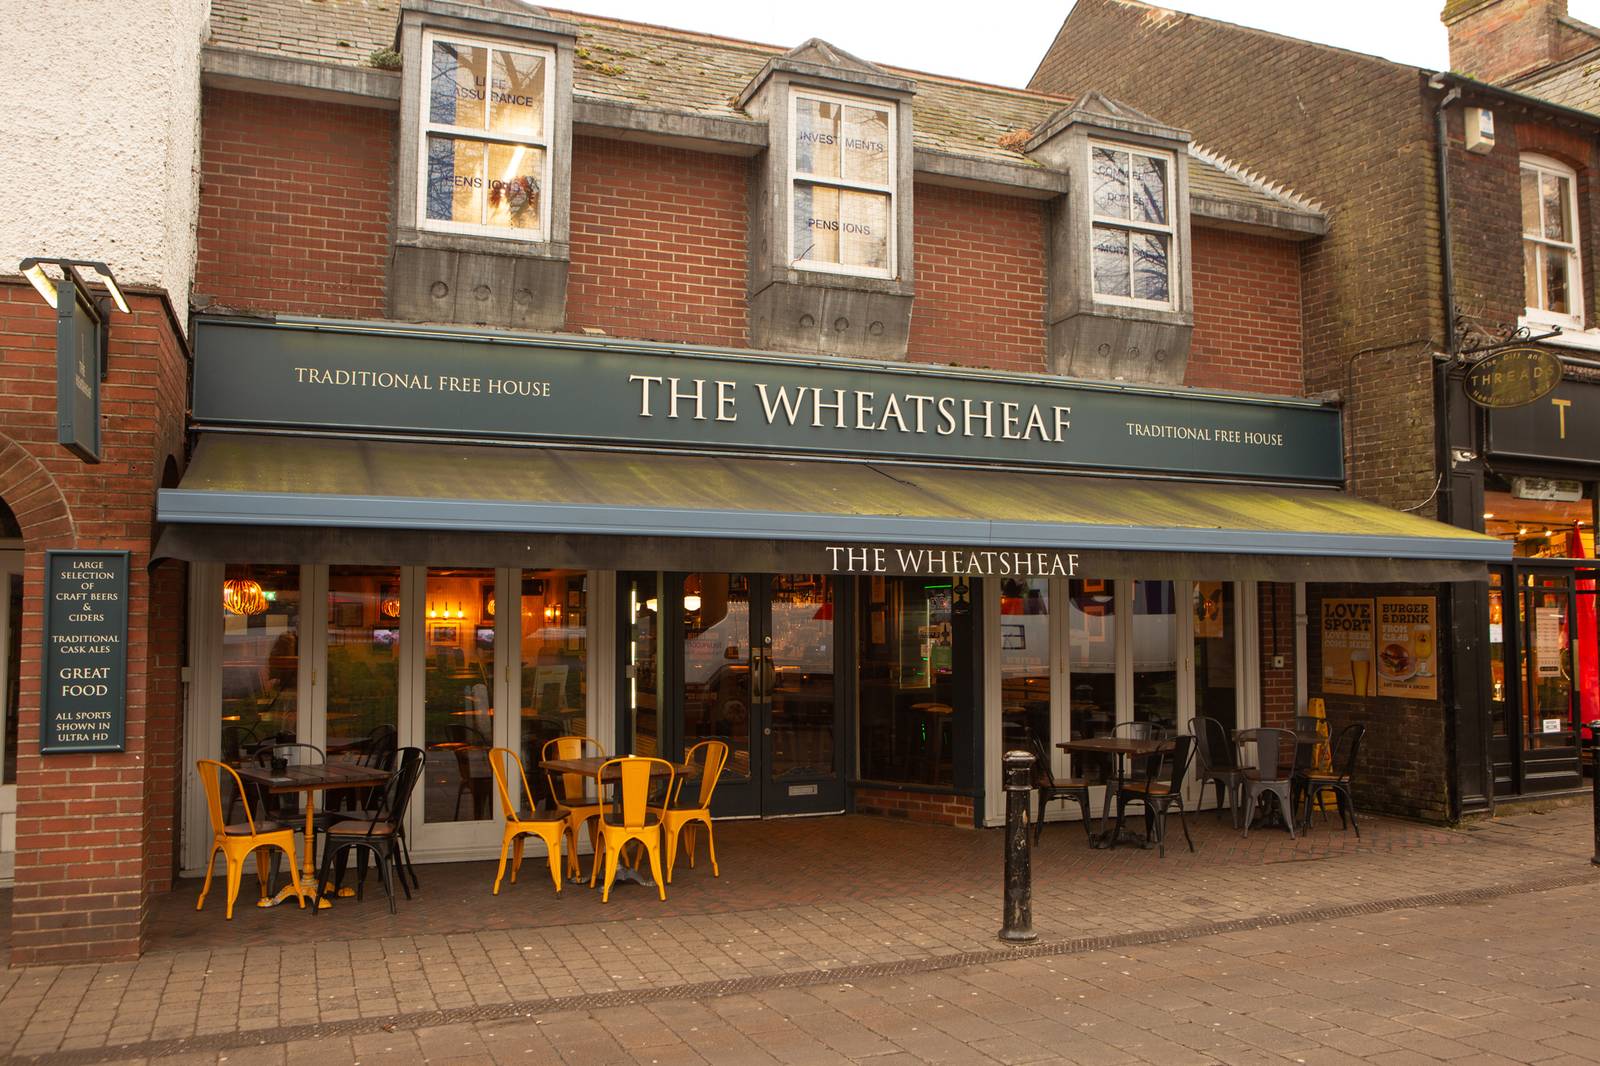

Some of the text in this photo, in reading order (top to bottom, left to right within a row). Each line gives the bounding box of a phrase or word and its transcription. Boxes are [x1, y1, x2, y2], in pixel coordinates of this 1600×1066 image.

[475, 75, 507, 90] LIFE
[453, 87, 533, 107] ASSURANCE
[800, 131, 884, 152] INVESTMENTS
[808, 218, 871, 235] PENSIONS
[295, 367, 551, 397] TRADITIONAL FREE HOUSE
[628, 374, 1071, 442] THE WHEATSHEAF
[1126, 423, 1284, 446] TRADITIONAL FREE HOUSE
[73, 561, 104, 569] LARGE
[825, 546, 1080, 576] THE WHEATSHEAF
[60, 571, 114, 580] SELECTION
[80, 582, 95, 590] OF
[55, 592, 118, 601] CRAFT BEERS
[82, 602, 92, 611] &
[1324, 603, 1370, 619] LOVE
[1382, 603, 1429, 613] BURGER
[68, 613, 105, 622] CIDERS
[1391, 614, 1429, 624] DRINK
[1324, 618, 1371, 632] SPORT
[52, 634, 120, 643] TRADITIONAL
[60, 645, 111, 654] CASK ALES
[59, 667, 111, 679] GREAT
[62, 684, 108, 697] FOOD
[55, 711, 112, 720] ALL SPORTS
[56, 722, 110, 731] SHOWN IN
[57, 732, 109, 742] ULTRA HD
